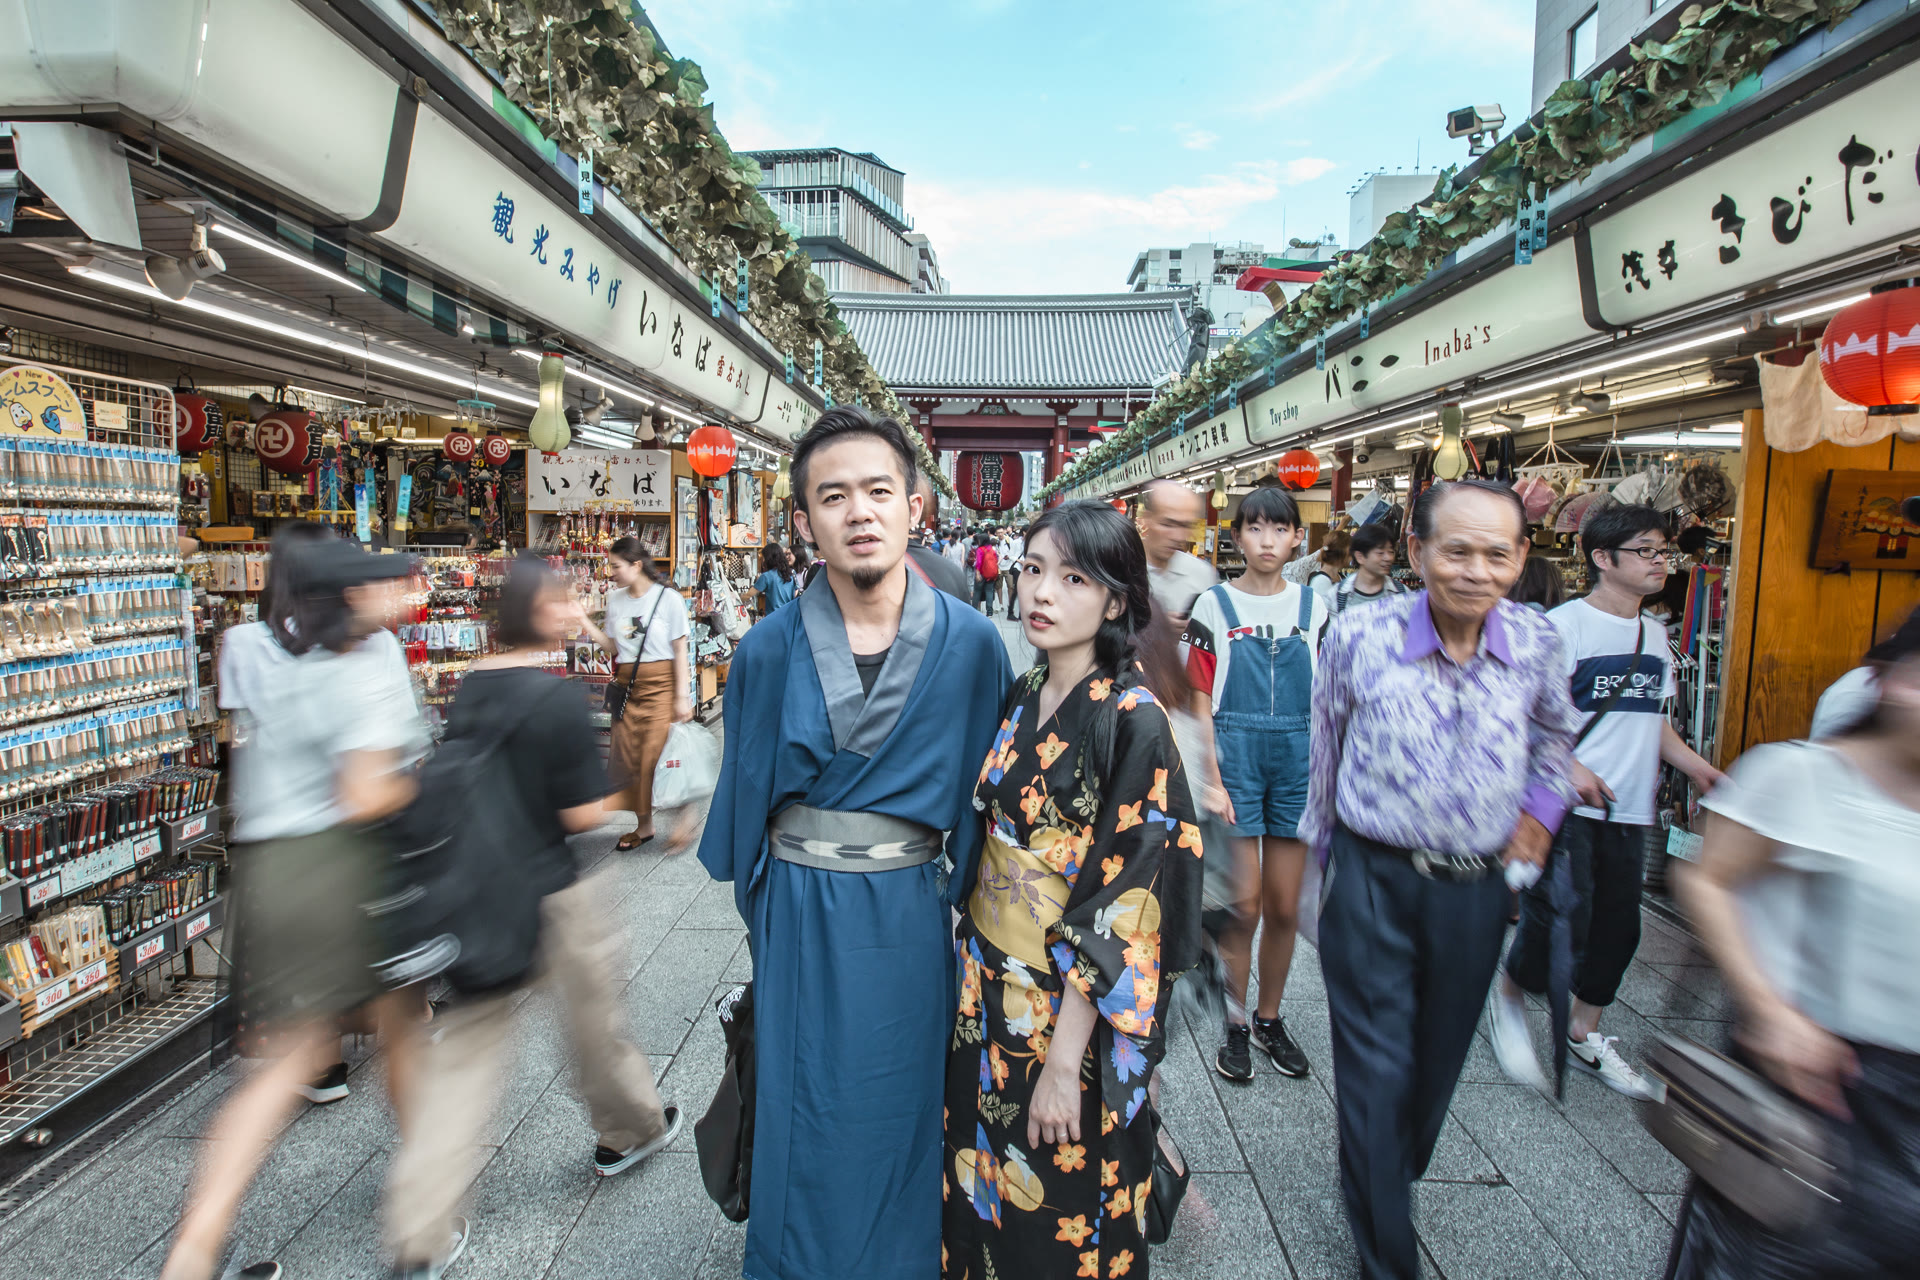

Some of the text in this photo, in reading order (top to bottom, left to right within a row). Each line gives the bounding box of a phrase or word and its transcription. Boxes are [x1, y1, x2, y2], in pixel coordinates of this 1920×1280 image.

[1711, 134, 1920, 265] きびだ
[491, 191, 750, 396] 観光みやげ いなば 雷おこし
[738, 259, 748, 301] 仲見世
[1424, 324, 1491, 366] Inaba's
[25, 370, 43, 379] New
[1269, 401, 1299, 427] Toy shop
[541, 469, 657, 497] いなば
[41, 988, 63, 1007] ¥300
